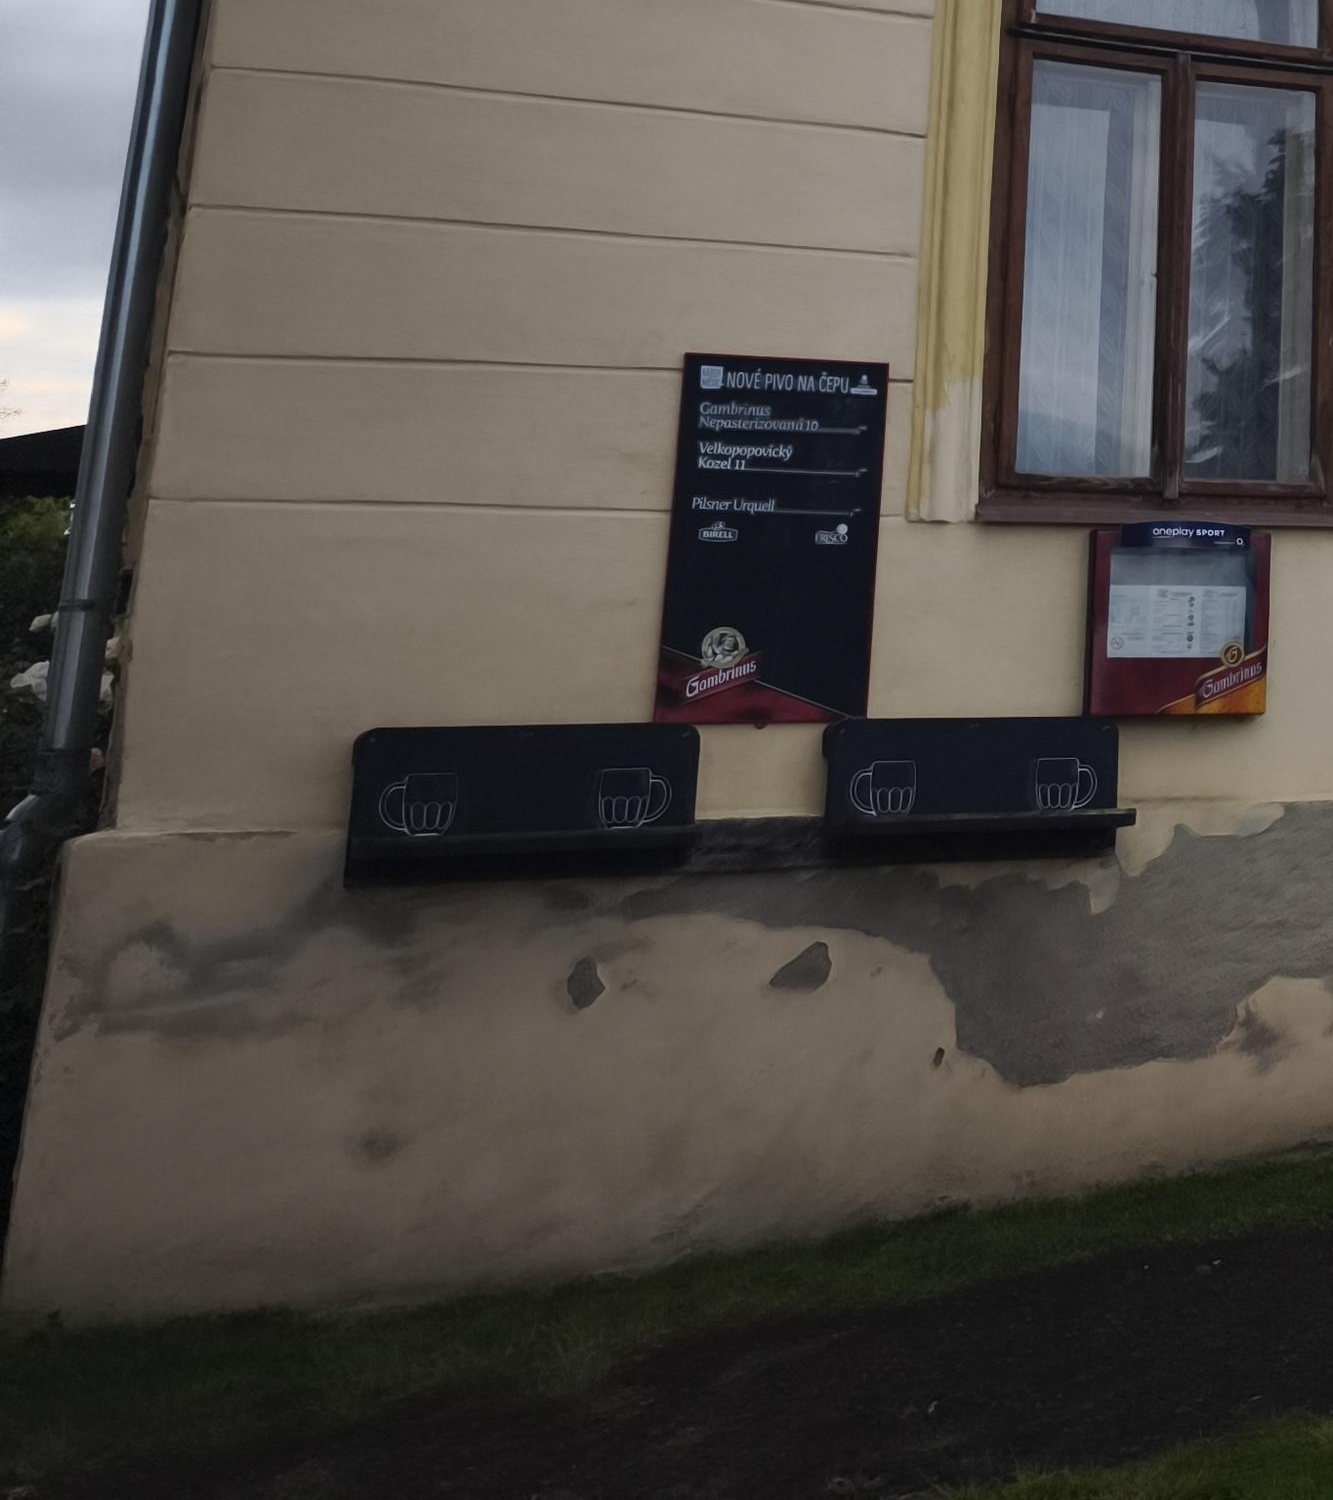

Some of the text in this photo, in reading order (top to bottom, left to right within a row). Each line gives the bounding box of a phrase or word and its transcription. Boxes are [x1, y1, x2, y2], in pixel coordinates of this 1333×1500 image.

[726, 368, 761, 389] NOVÉ
[764, 373, 794, 391] PIVO
[797, 375, 816, 392] NA
[818, 371, 849, 393] ČEPU
[700, 402, 772, 416] Gambrinus
[806, 421, 819, 432] 10
[698, 441, 793, 461] Velkopopovický
[698, 456, 746, 470] Kozel 11
[692, 497, 776, 515] Pilsner Urquell
[702, 530, 848, 544] BIRELL FRISCO
[1152, 526, 1225, 538] oneplay SPORT
[686, 660, 757, 698] Gambrinus
[1199, 661, 1263, 699] Gambrinus
